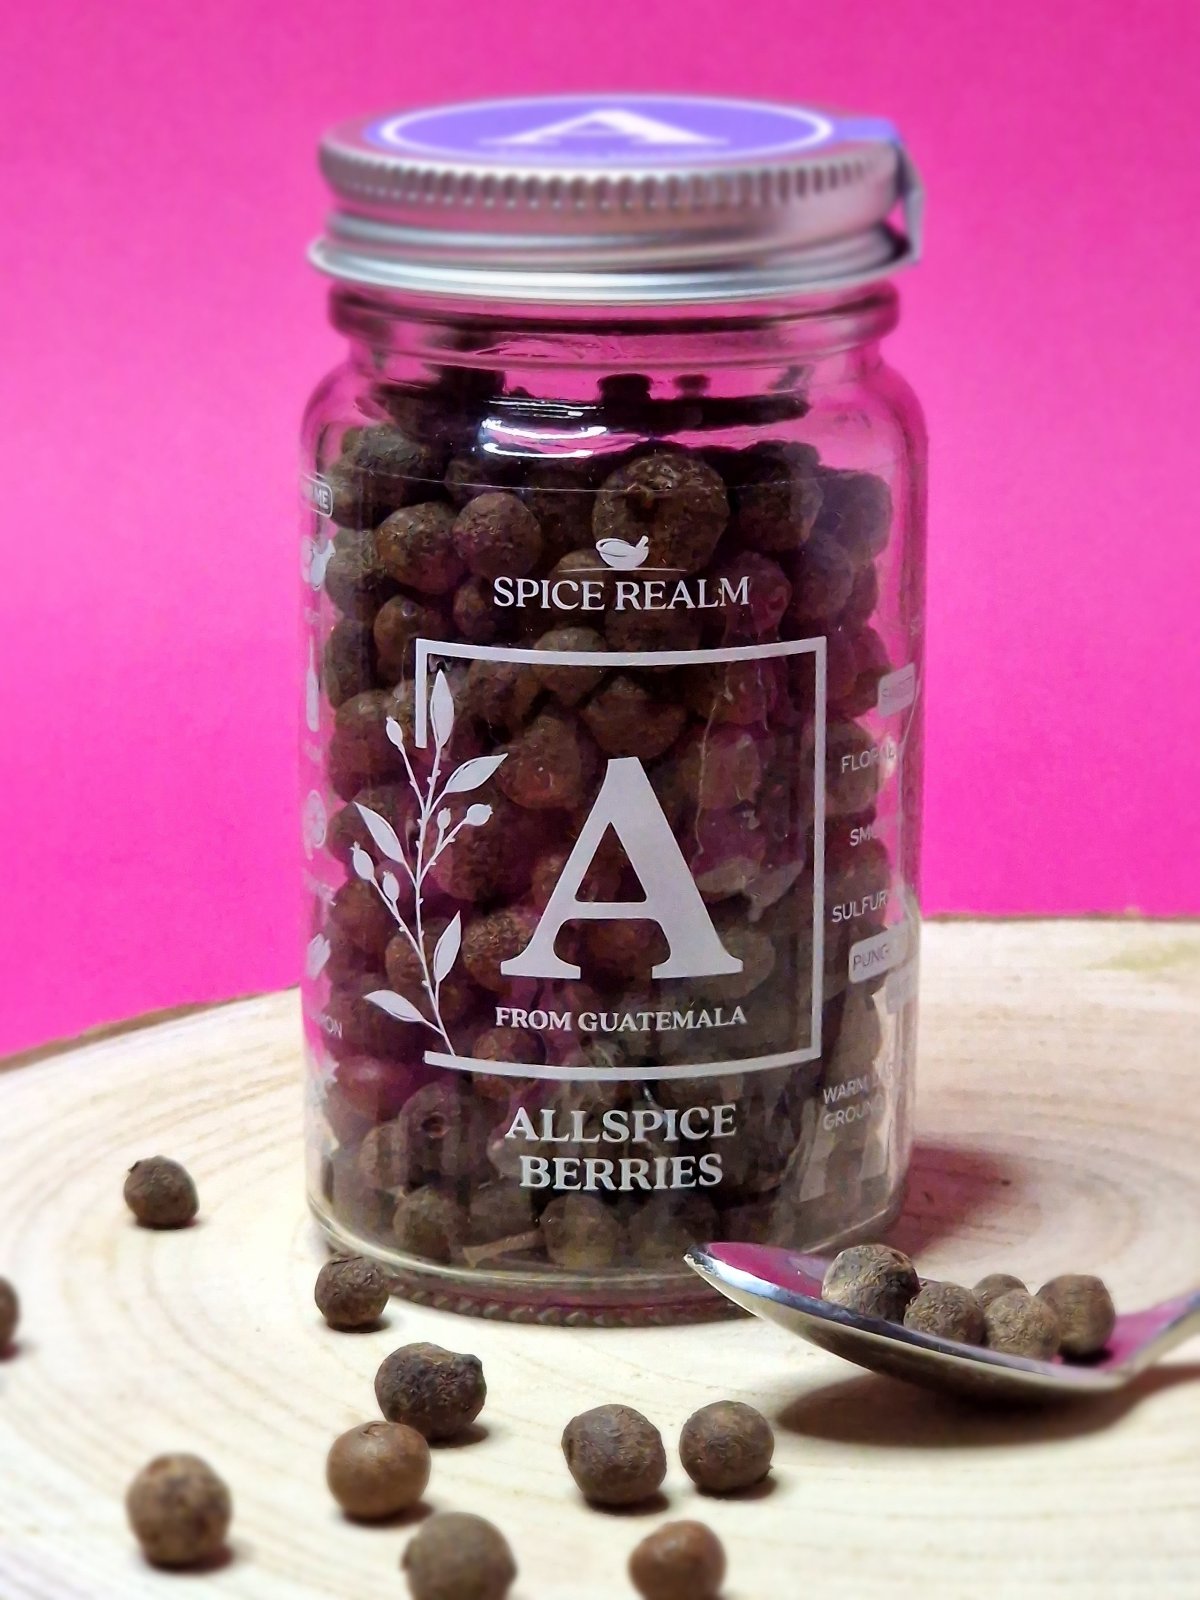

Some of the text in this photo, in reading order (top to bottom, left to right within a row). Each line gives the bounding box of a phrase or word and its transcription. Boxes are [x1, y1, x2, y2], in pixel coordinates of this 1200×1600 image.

[478, 109, 730, 146] A
[493, 576, 750, 611] SPICE REALM
[500, 756, 744, 980] A
[495, 1005, 747, 1033] FROM GUATEMALA
[505, 1104, 737, 1143] ALLSPICE
[519, 1153, 723, 1191] BERRIES
